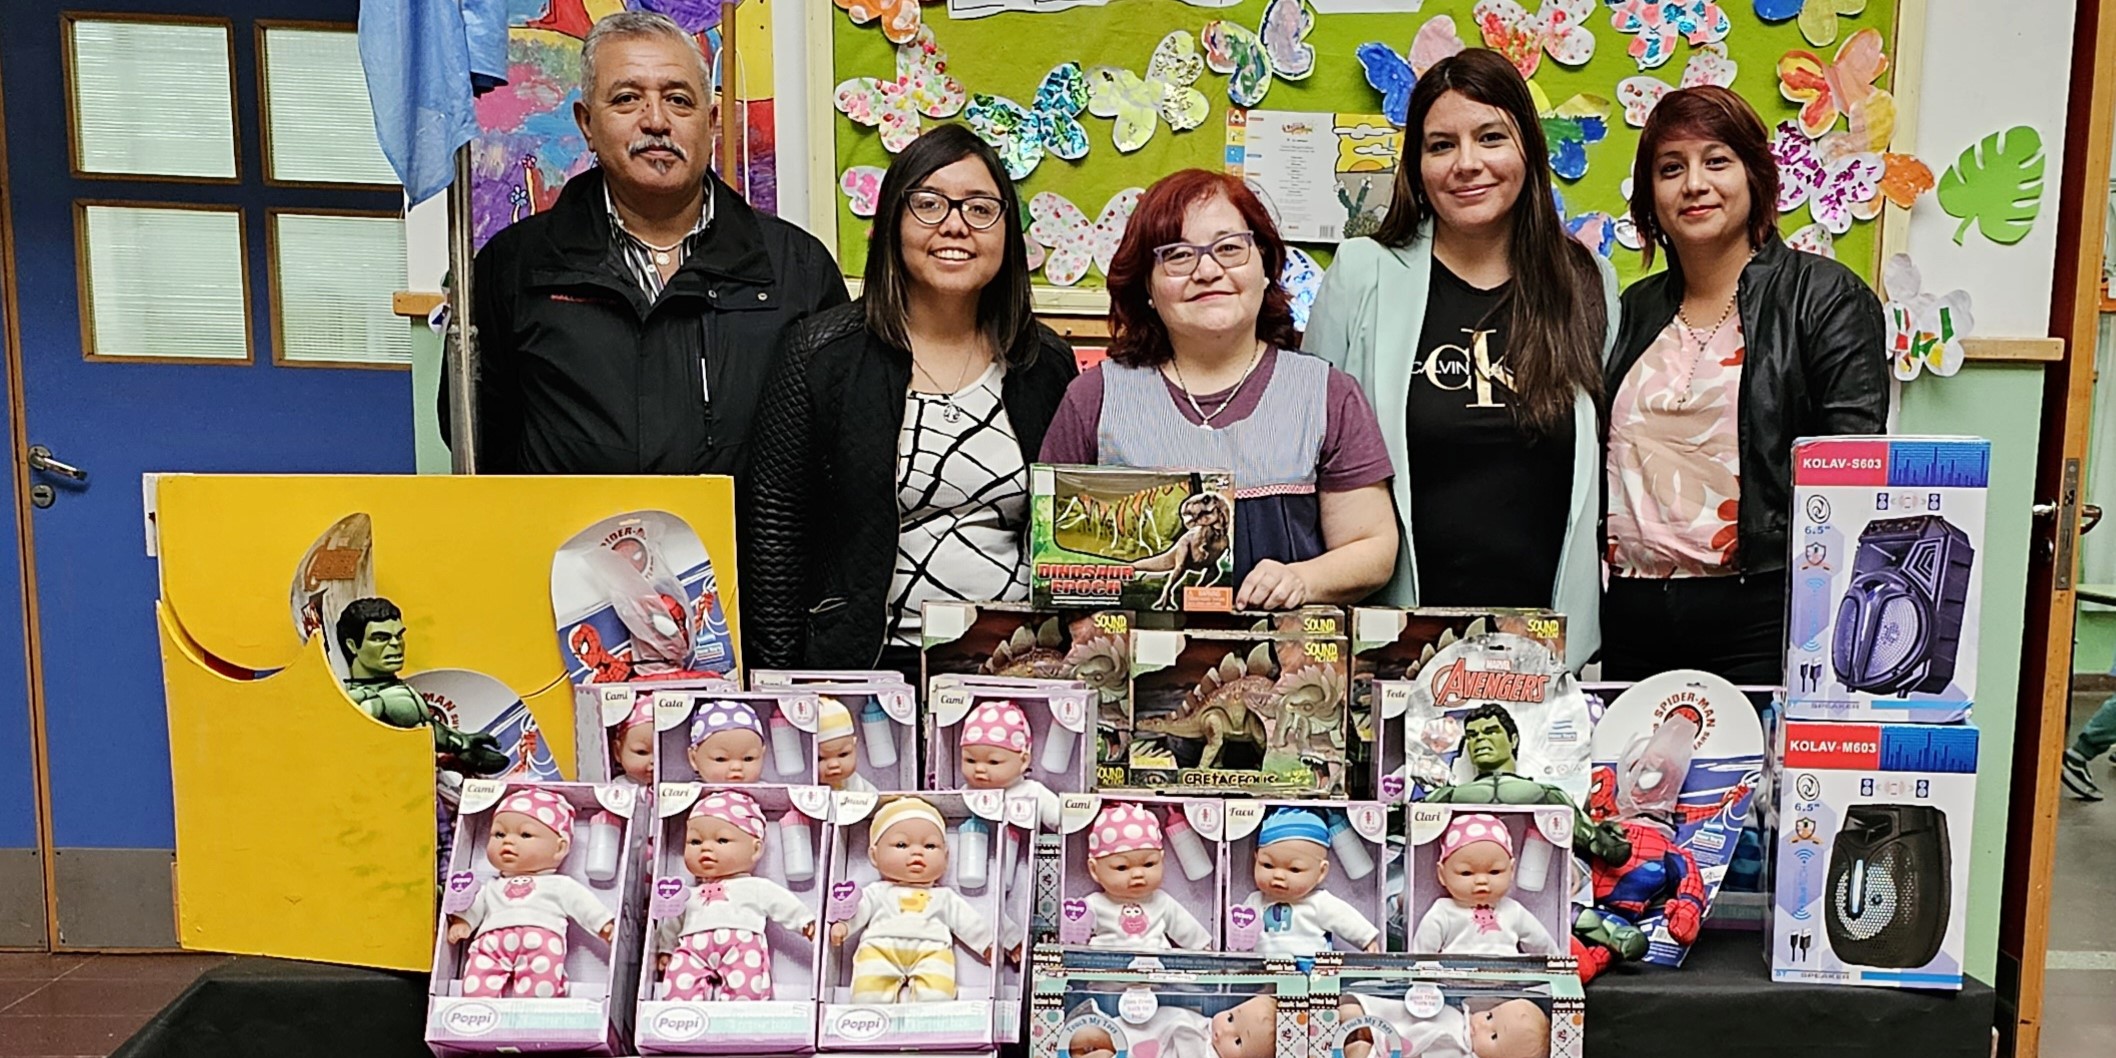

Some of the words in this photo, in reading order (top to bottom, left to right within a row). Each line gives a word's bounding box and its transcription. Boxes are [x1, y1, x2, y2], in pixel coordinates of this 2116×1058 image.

[1803, 458, 1882, 469] KOLAV-S603
[1037, 564, 1135, 580] DINOSAUR
[1051, 579, 1122, 595] EPOCH
[1094, 614, 1127, 628] SOUND
[1303, 618, 1336, 631] SOUND
[1527, 619, 1559, 633] SOUND
[1304, 642, 1338, 656] SOUND
[1432, 658, 1551, 707] AVENGERS
[605, 690, 629, 701] Cami
[940, 695, 965, 705] Cami
[658, 698, 684, 708] Cata
[1655, 692, 1716, 729] SPIDER-MAN
[1789, 741, 1877, 753] KOLAV-M603
[1184, 772, 1278, 785] CRETACEOUS
[467, 782, 496, 794] Cami
[661, 787, 690, 797] Clari
[1065, 799, 1091, 810] Cami
[1414, 811, 1441, 821] Clari
[450, 1011, 492, 1027] Poppi
[658, 1017, 699, 1031] Poppi
[841, 1018, 881, 1032] Poppi
[1066, 1018, 1088, 1033] Touch
[1089, 1017, 1100, 1025] My
[1103, 1020, 1119, 1034] Toes
[1342, 1019, 1362, 1033] Touch
[1363, 1017, 1376, 1026] My
[1377, 1018, 1394, 1035] Toes
